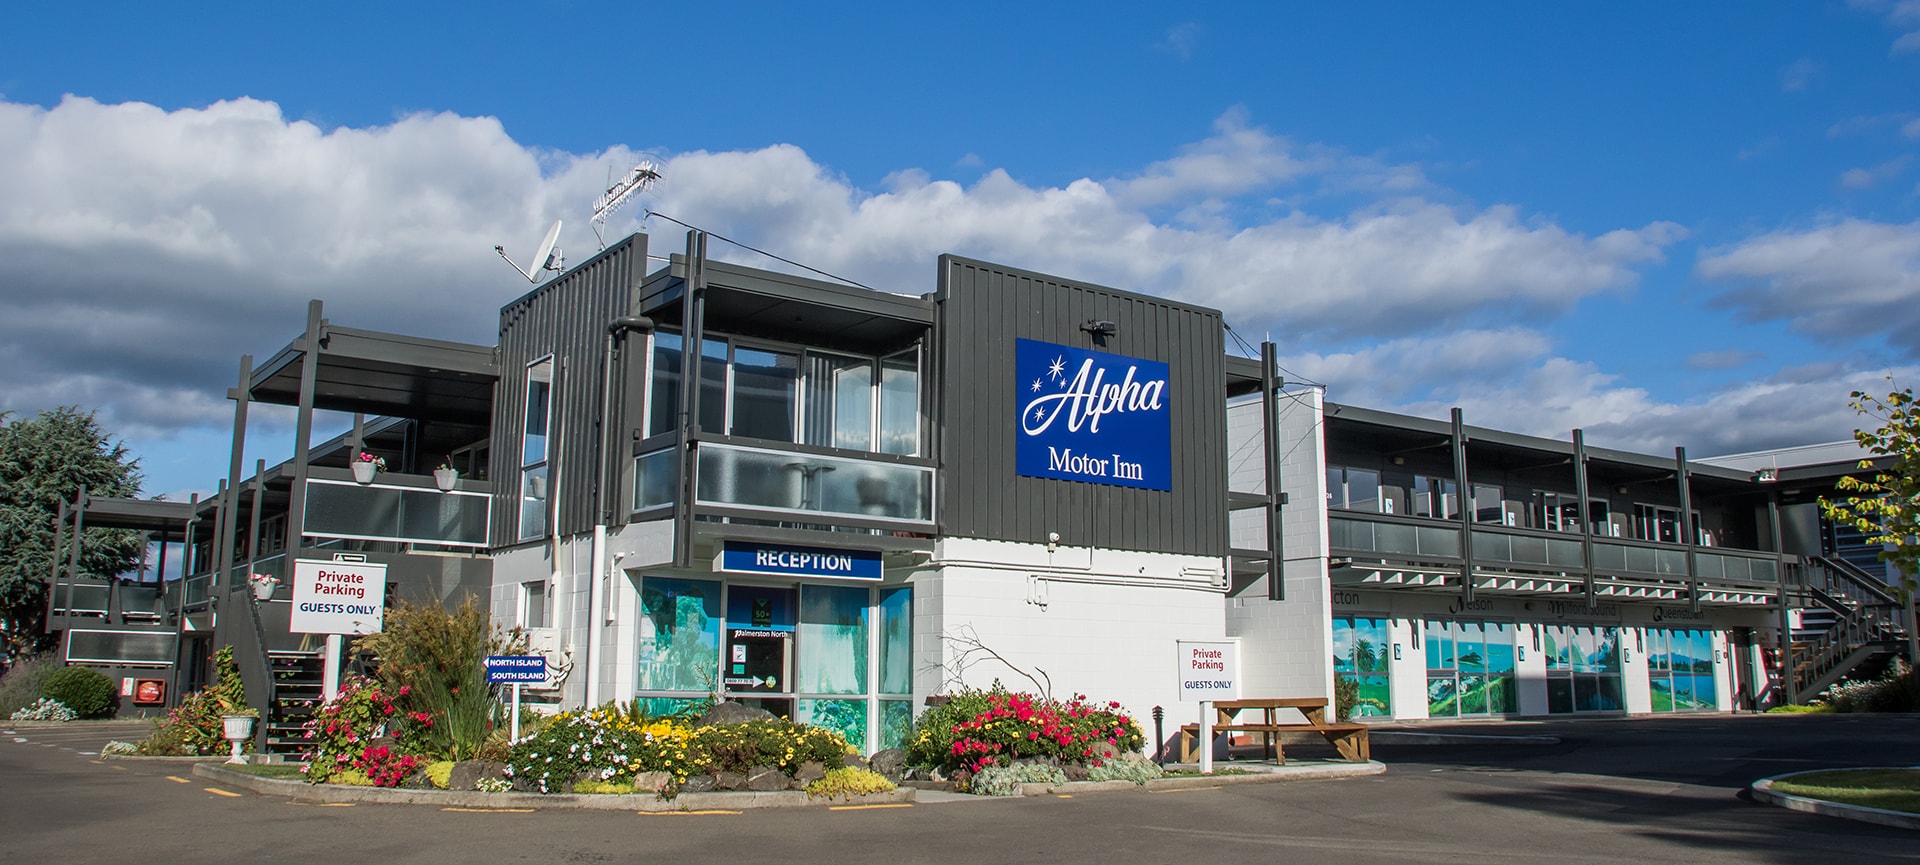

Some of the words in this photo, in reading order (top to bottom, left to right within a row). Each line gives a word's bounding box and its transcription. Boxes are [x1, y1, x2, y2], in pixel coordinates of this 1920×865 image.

[1023, 358, 1165, 436] Alpha
[1048, 446, 1109, 476] Motor
[1112, 454, 1143, 481] Inn
[756, 549, 852, 571] RECEPTION
[318, 570, 364, 584] Private
[315, 583, 365, 599] Parking
[300, 602, 344, 614] GUESTS
[346, 604, 376, 615] ONLY
[734, 630, 770, 638] Palmerston
[1193, 648, 1222, 658] Private
[490, 659, 515, 667] NORTH
[516, 659, 543, 667] ISLAND
[1192, 659, 1224, 672] Parking
[492, 672, 517, 680] SOUTH
[518, 672, 544, 680] ISLAND
[1184, 680, 1213, 689] GUESTS
[1213, 680, 1232, 689] ONLY
